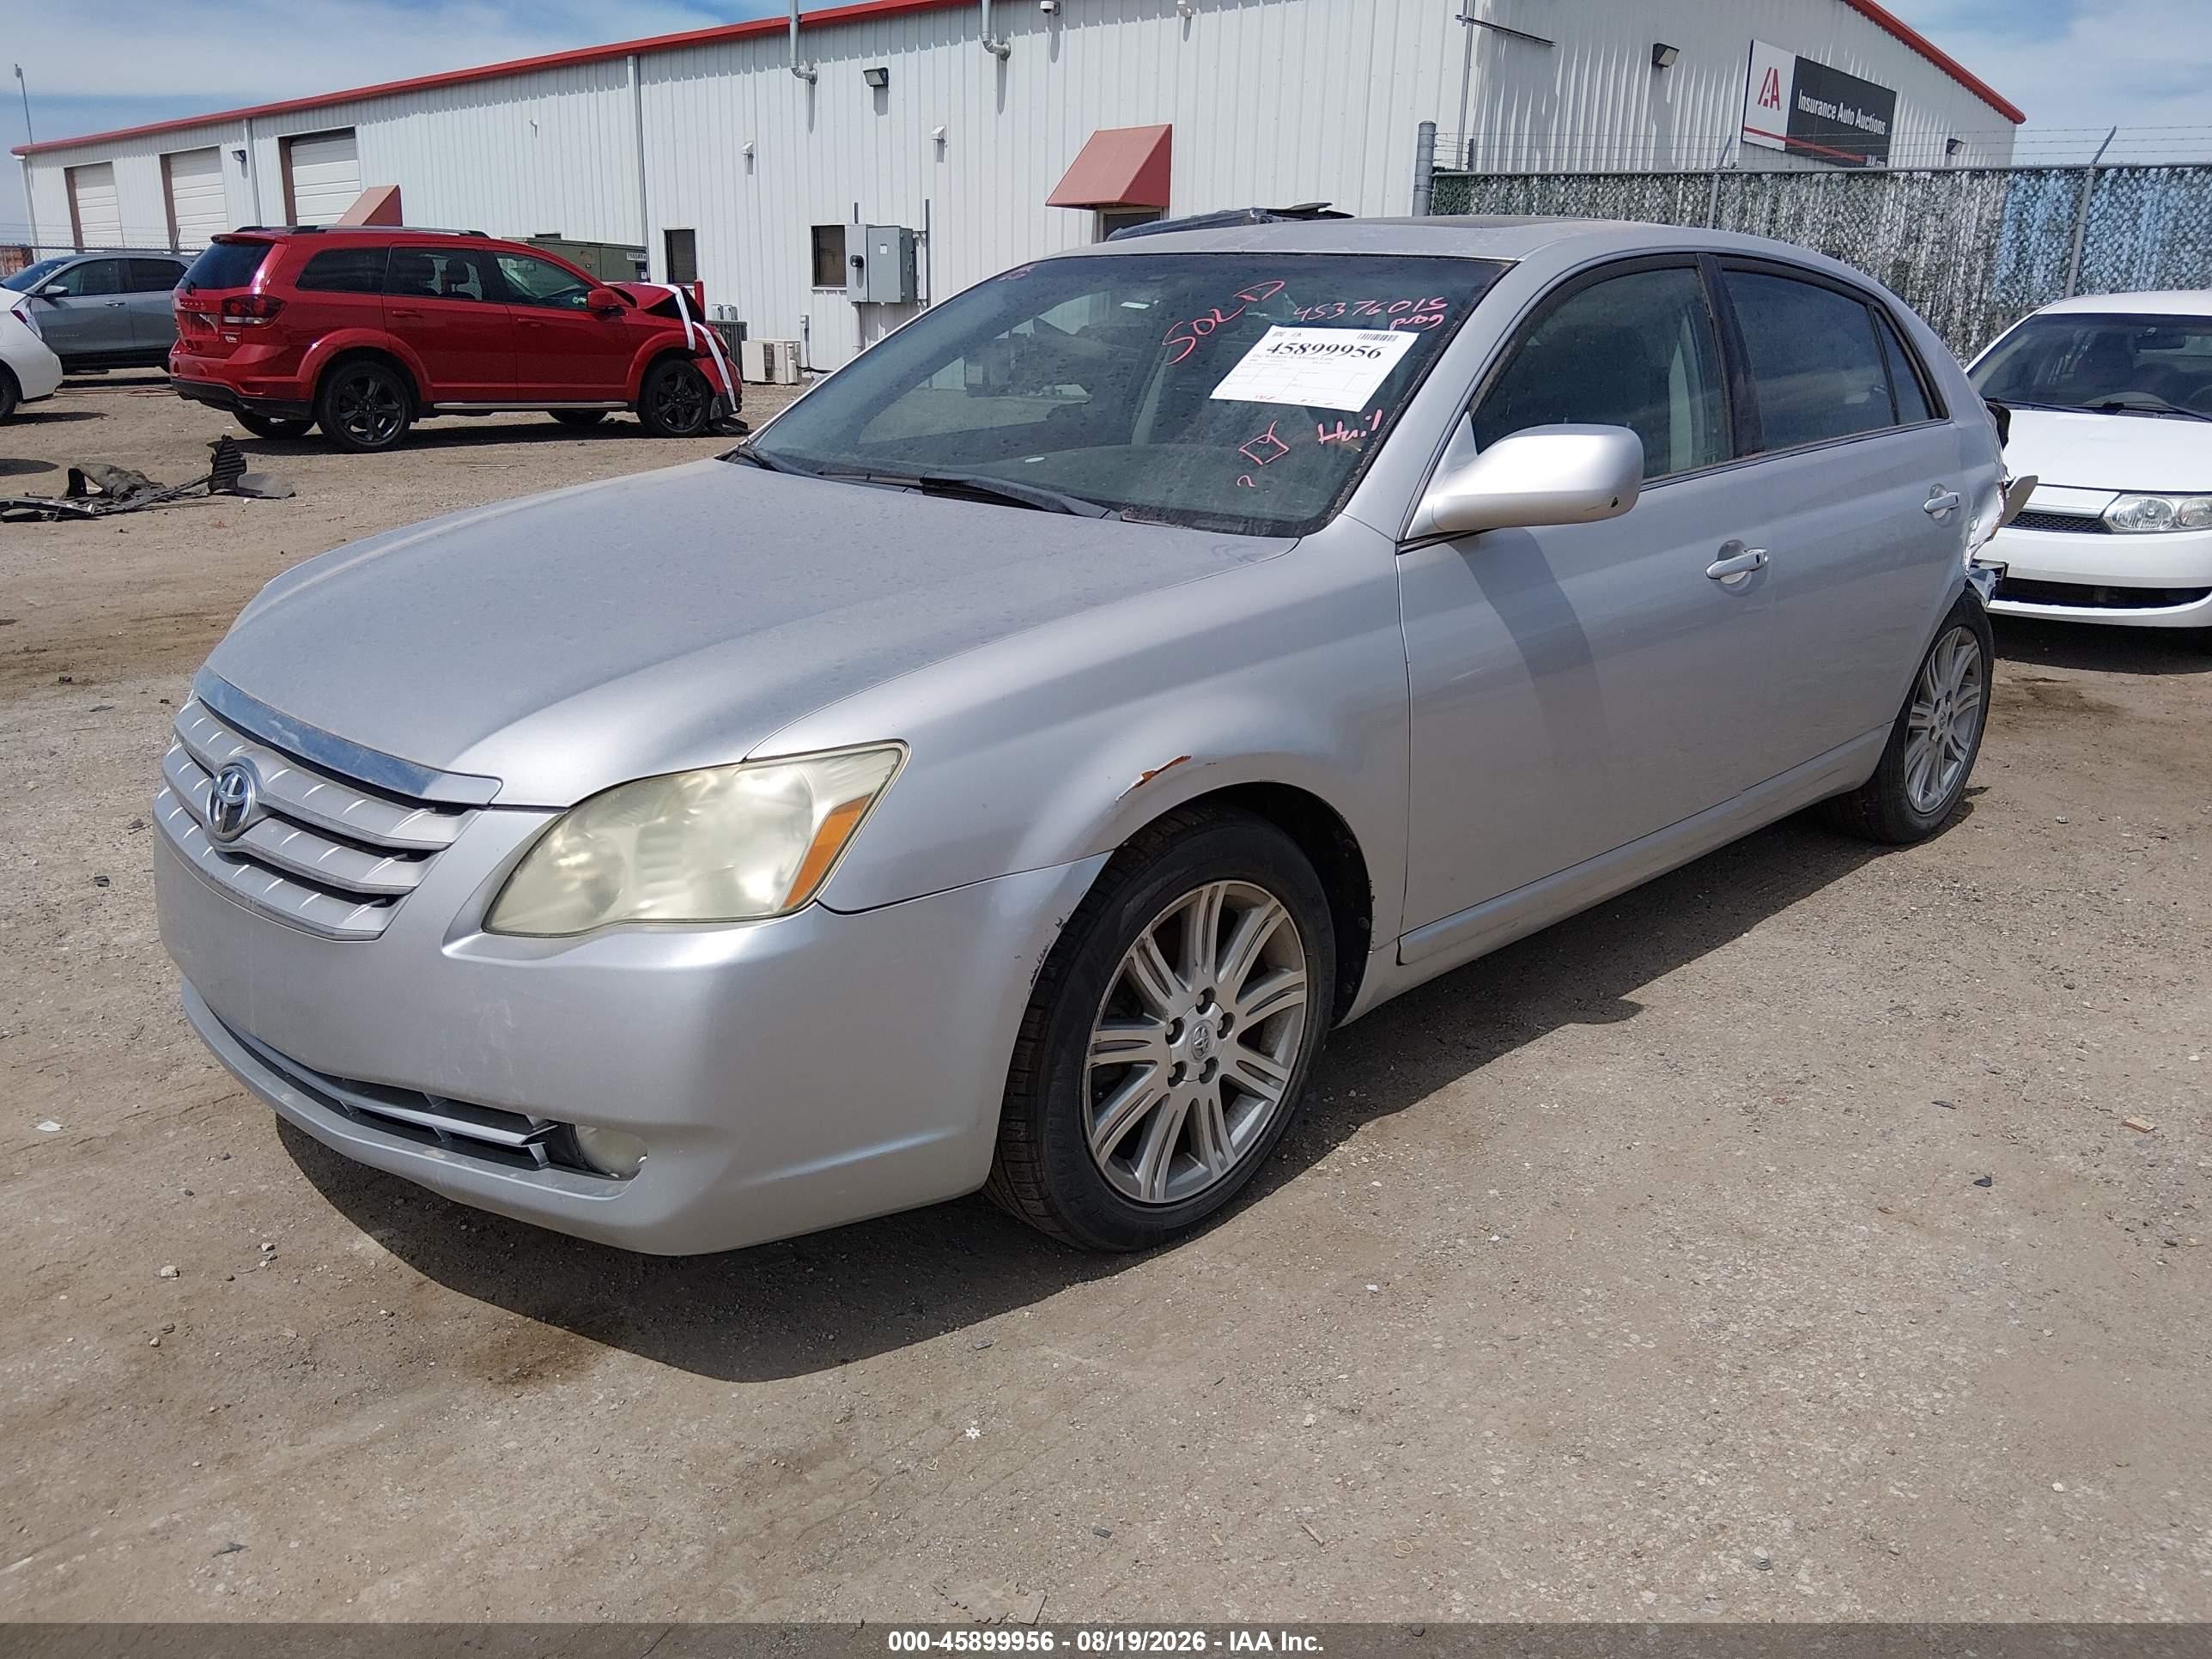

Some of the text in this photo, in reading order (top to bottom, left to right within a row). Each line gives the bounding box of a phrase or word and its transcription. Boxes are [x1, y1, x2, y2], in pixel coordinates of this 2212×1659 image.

[1797, 88, 1887, 136] Insurance Auto Auctions
[1266, 343, 1387, 360] 45899956
